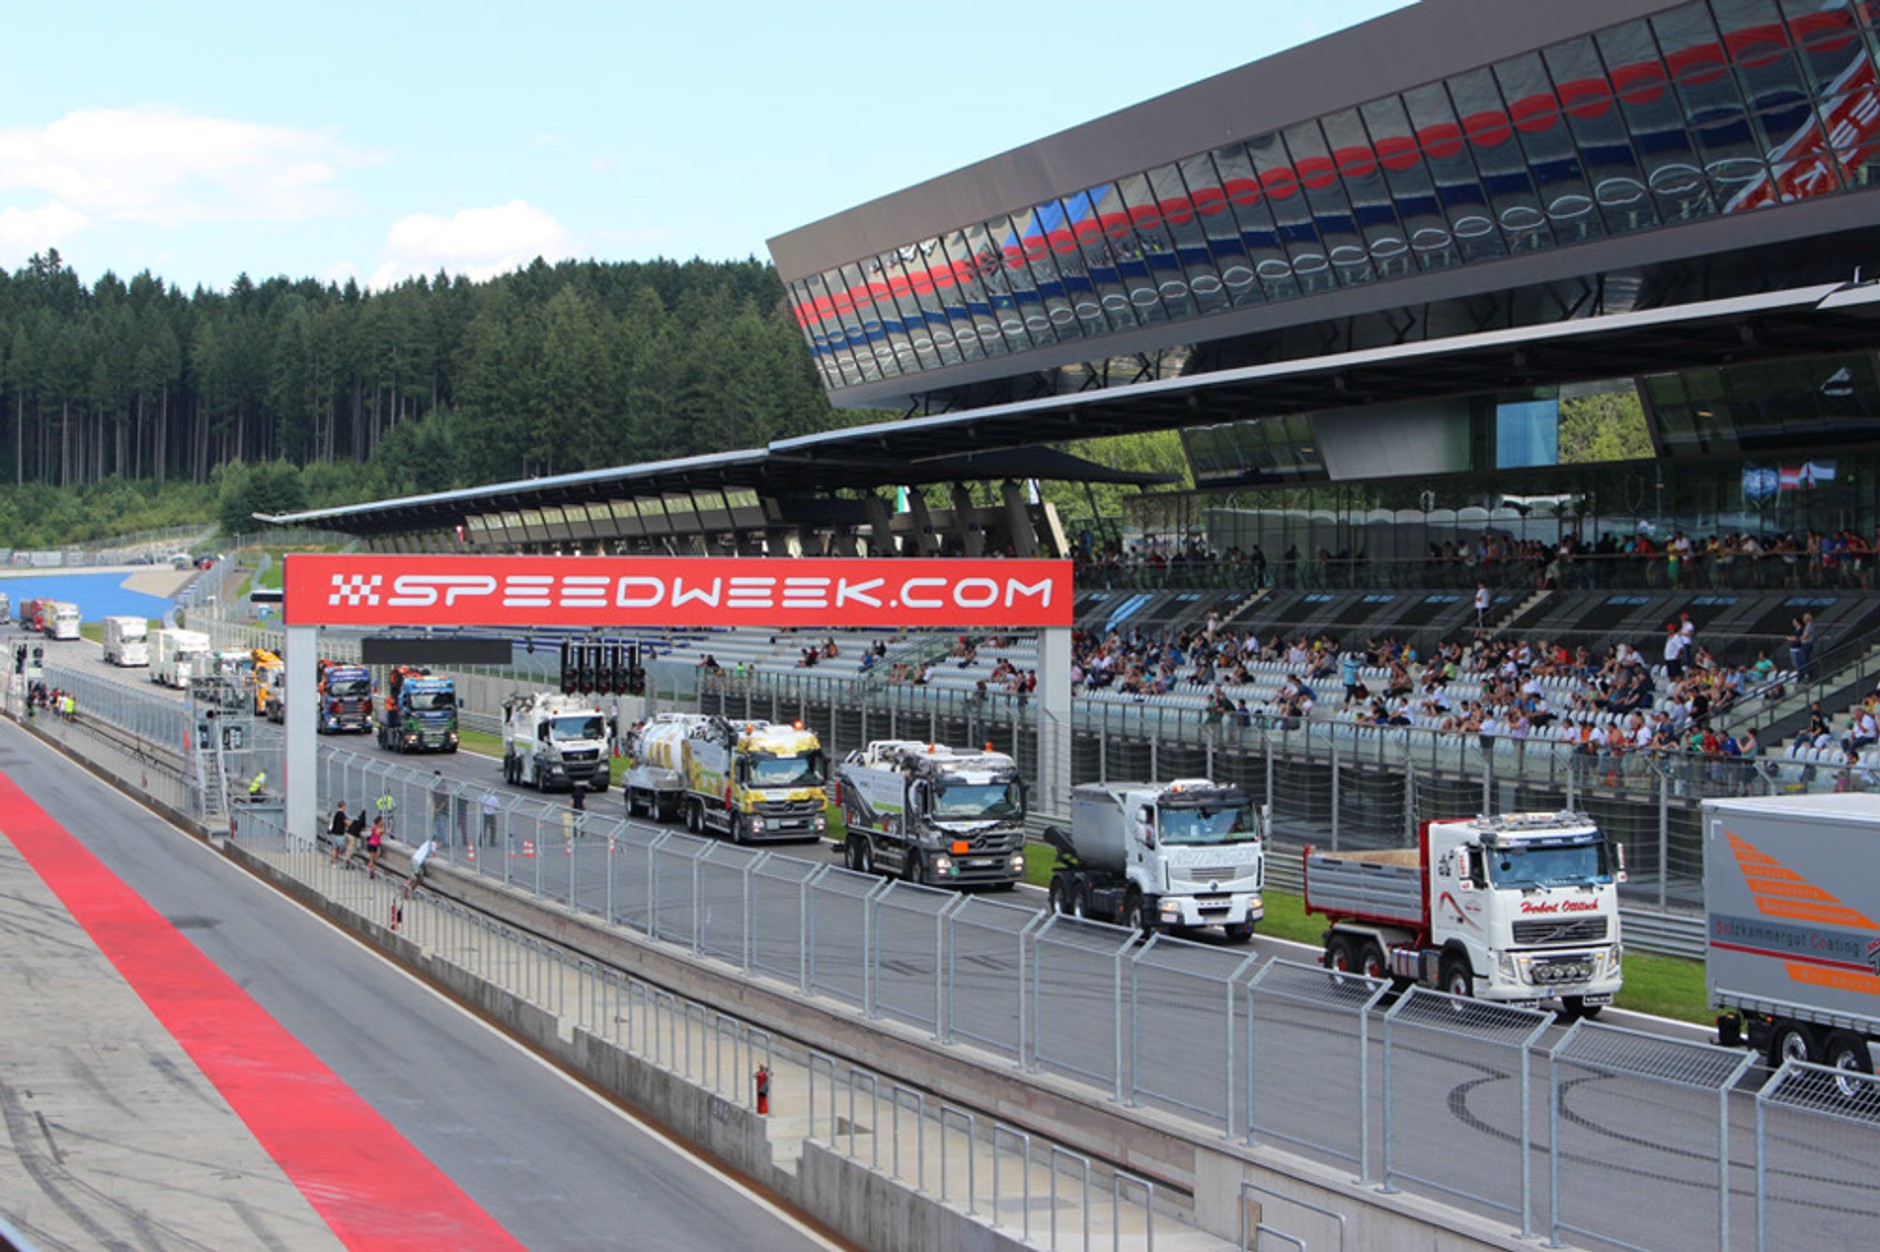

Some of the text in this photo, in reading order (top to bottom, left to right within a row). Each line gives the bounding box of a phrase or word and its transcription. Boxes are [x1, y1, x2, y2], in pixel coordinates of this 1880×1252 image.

[387, 575, 1052, 607] SPEEDWEEK.COM
[1715, 918, 1807, 948] Salzkammergut
[1809, 933, 1861, 959] Coating
